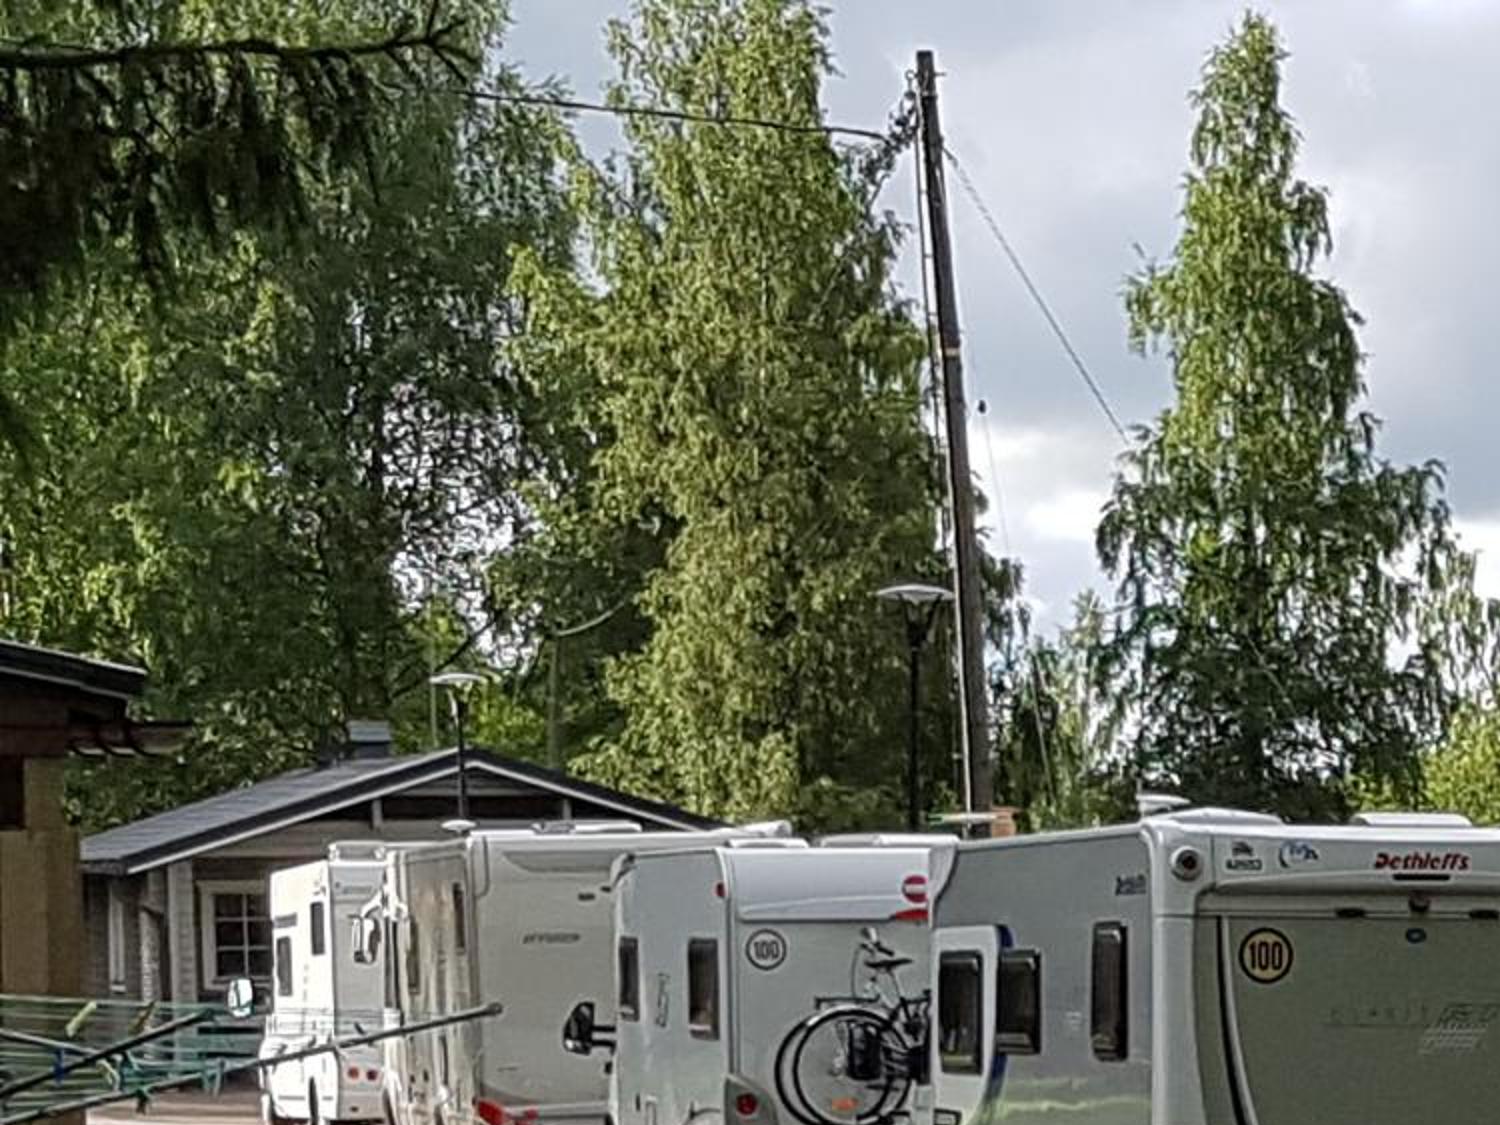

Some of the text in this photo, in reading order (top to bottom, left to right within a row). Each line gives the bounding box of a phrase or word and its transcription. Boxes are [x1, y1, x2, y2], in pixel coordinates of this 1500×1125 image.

[1375, 851, 1470, 870] Dethleffs
[753, 940, 780, 960] 100
[1249, 940, 1283, 971] 100
